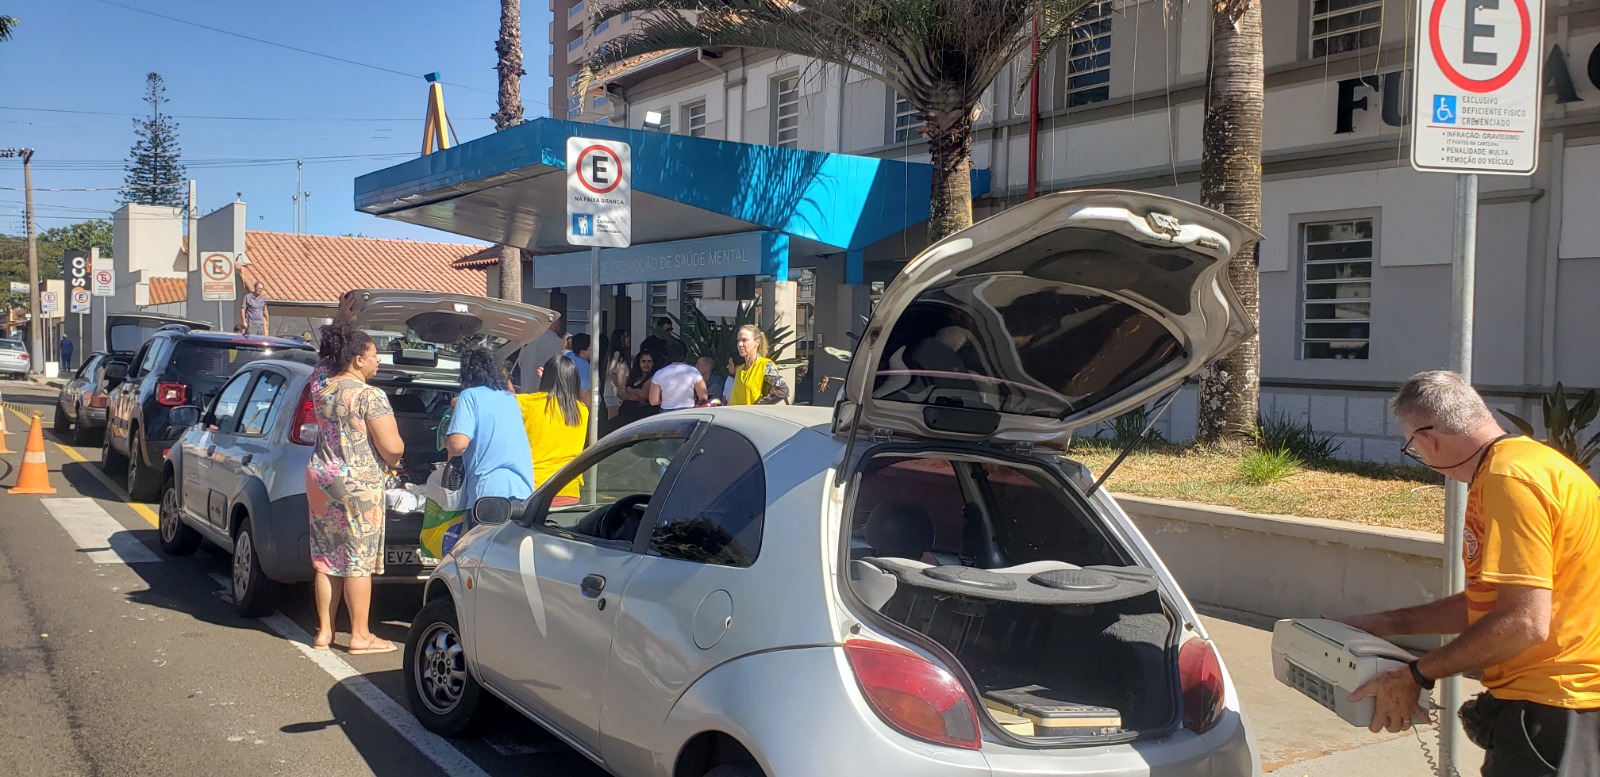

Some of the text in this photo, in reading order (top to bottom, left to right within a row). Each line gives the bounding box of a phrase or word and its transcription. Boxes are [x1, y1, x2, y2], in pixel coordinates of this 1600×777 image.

[1463, 0, 1499, 66] E
[1462, 96, 1498, 105] EXCLUSIVO
[1461, 106, 1526, 117] DEFICIENTE FÍSICO
[1461, 117, 1511, 127] CREDENCIADO
[1446, 155, 1477, 165] REMOÇÃO
[1488, 156, 1514, 165] VEÍCULO
[592, 155, 608, 184] E
[660, 256, 672, 270] DE
[674, 251, 705, 268] SAÚDE
[709, 249, 748, 265] MENTAL
